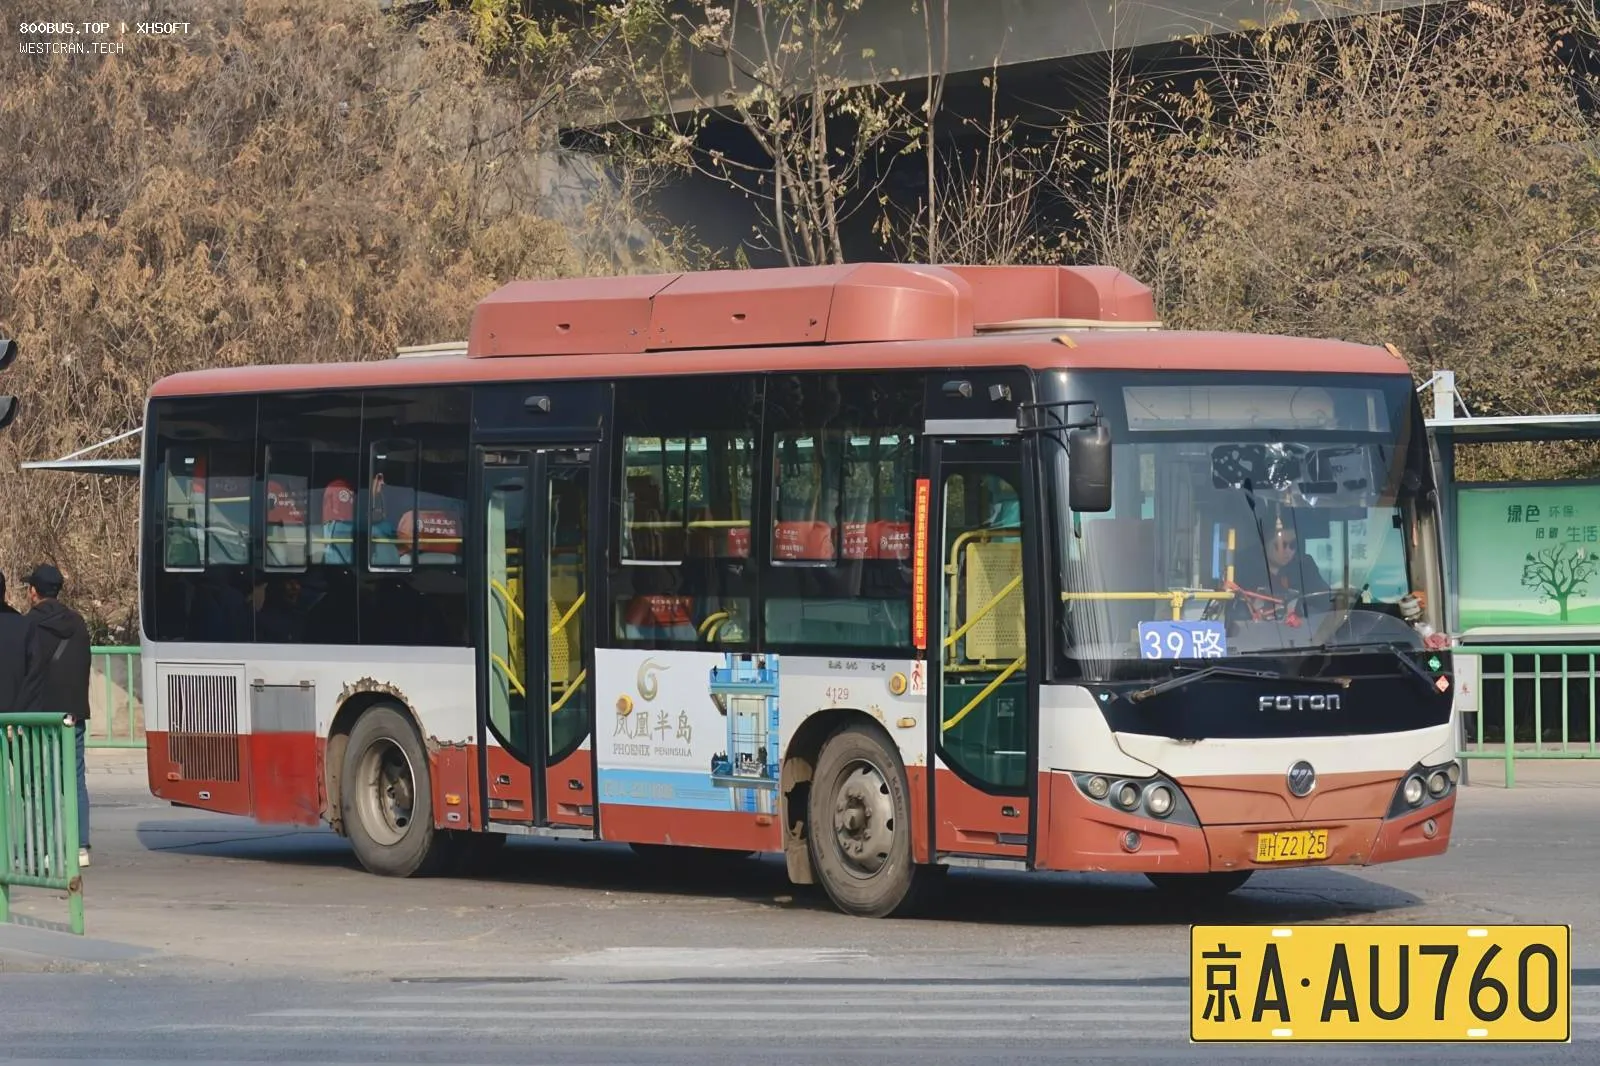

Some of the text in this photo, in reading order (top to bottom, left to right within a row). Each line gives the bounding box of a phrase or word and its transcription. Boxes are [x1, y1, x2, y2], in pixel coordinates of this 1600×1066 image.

[1507, 504, 1540, 523] 绿色
[825, 685, 849, 701] 4129
[1259, 694, 1341, 711] FOTON
[613, 709, 692, 744] 凤凰半岛
[613, 743, 692, 758] PHOENIX PENINSULA
